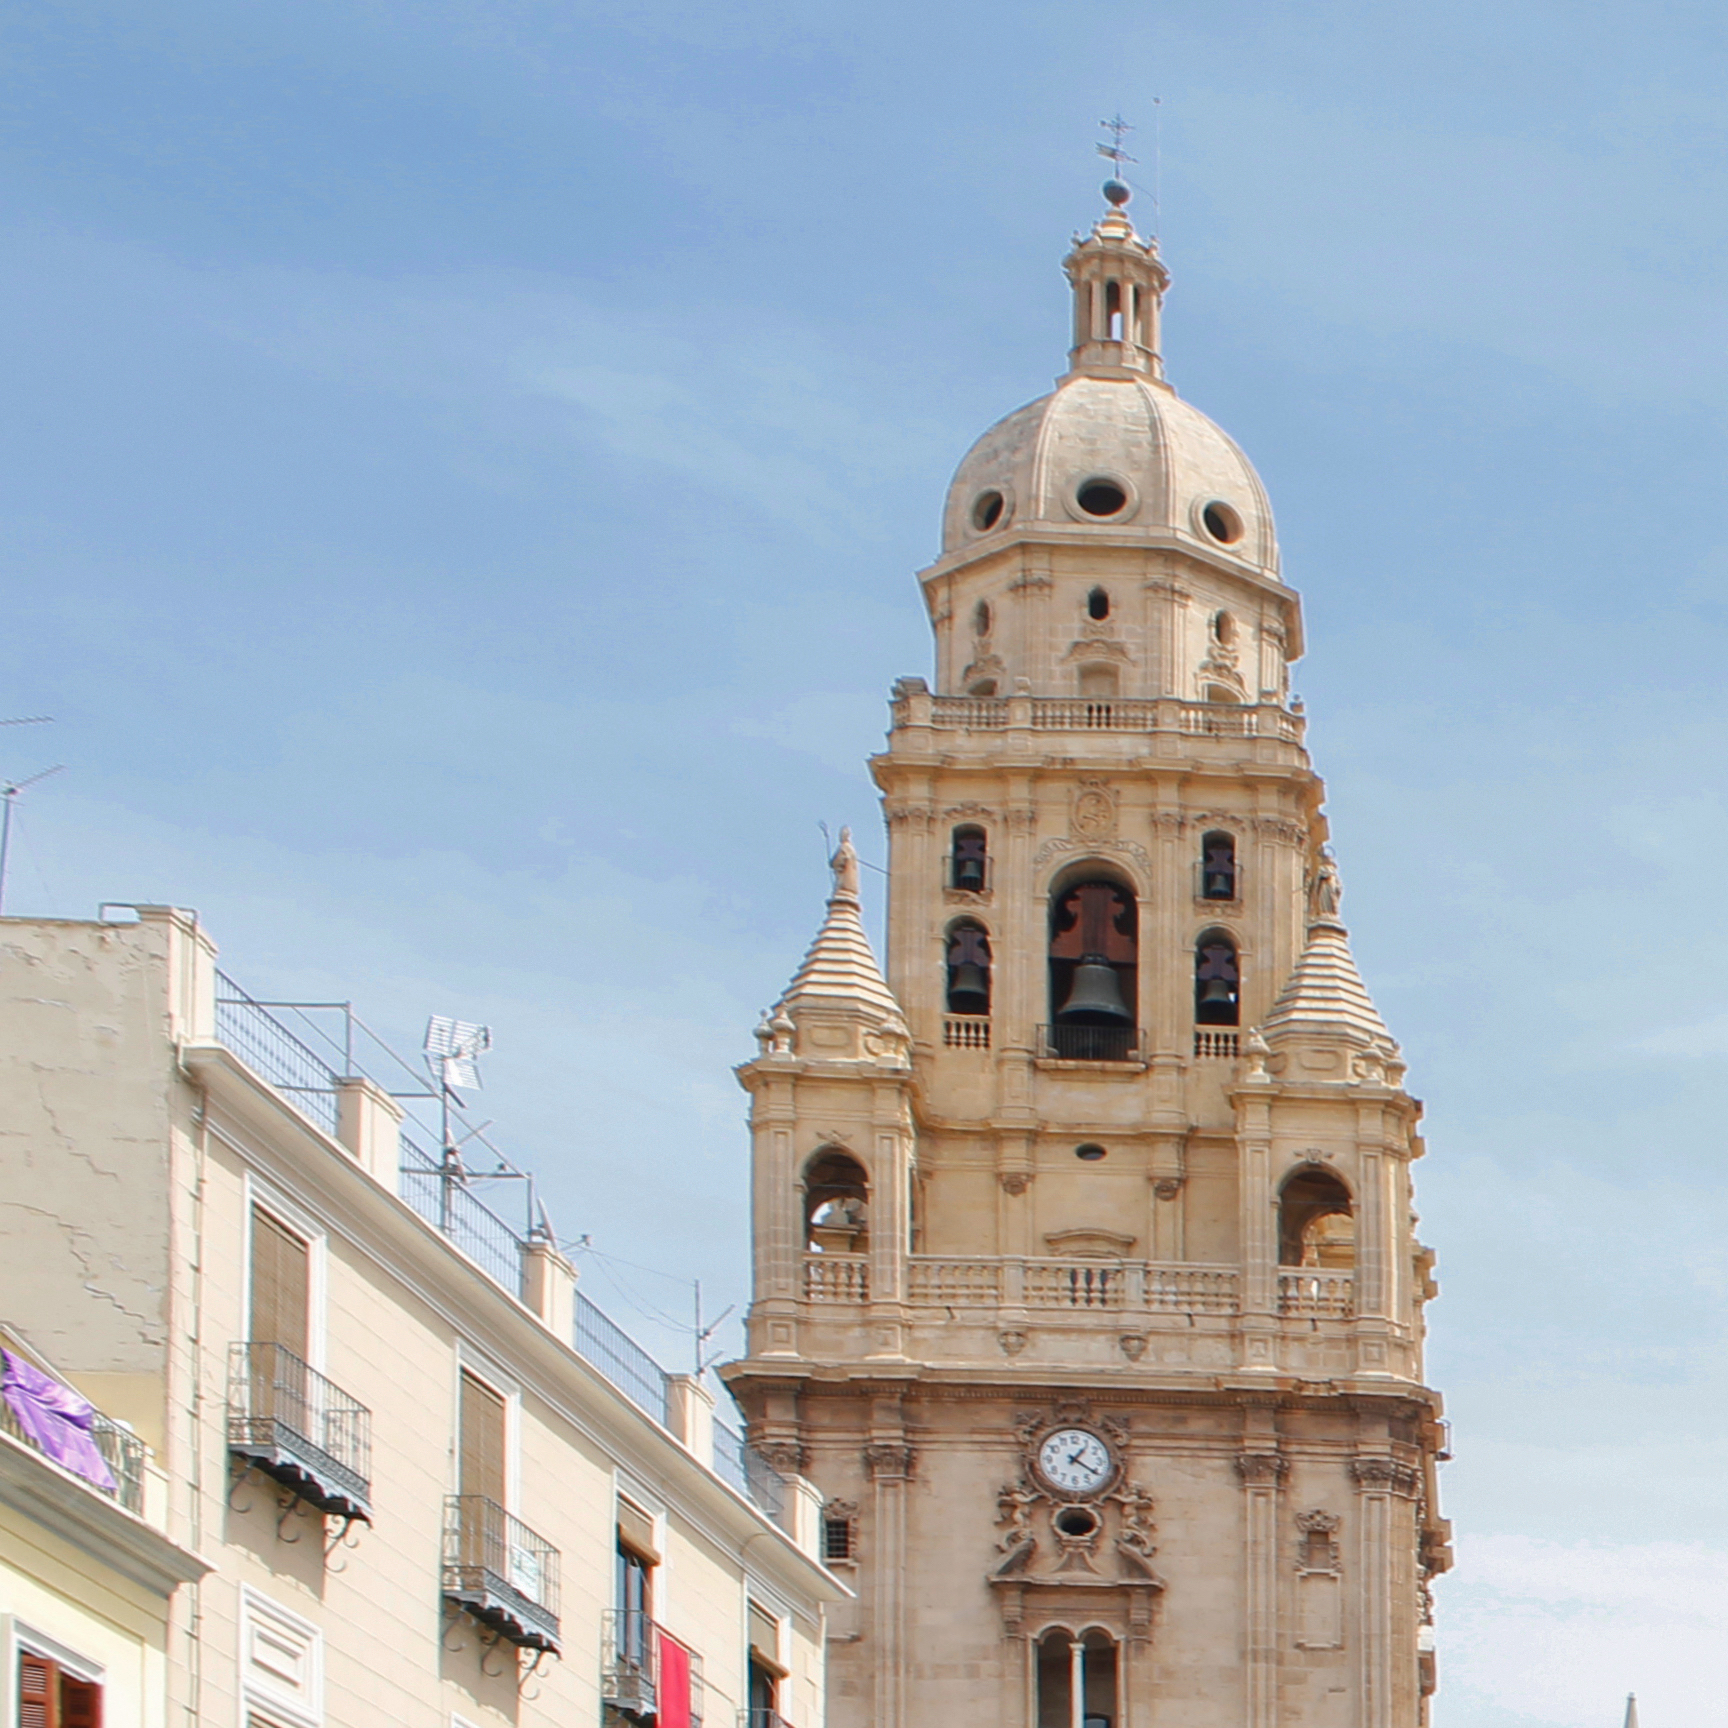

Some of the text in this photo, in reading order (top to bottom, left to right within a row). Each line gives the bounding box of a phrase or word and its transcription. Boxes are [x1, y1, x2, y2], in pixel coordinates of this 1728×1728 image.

[1070, 1436, 1080, 1444] 12
[1046, 1455, 1053, 1464] 9
[1096, 1457, 1102, 1466] 3
[1061, 1473, 1066, 1482] 7
[1071, 1475, 1079, 1485] 6
